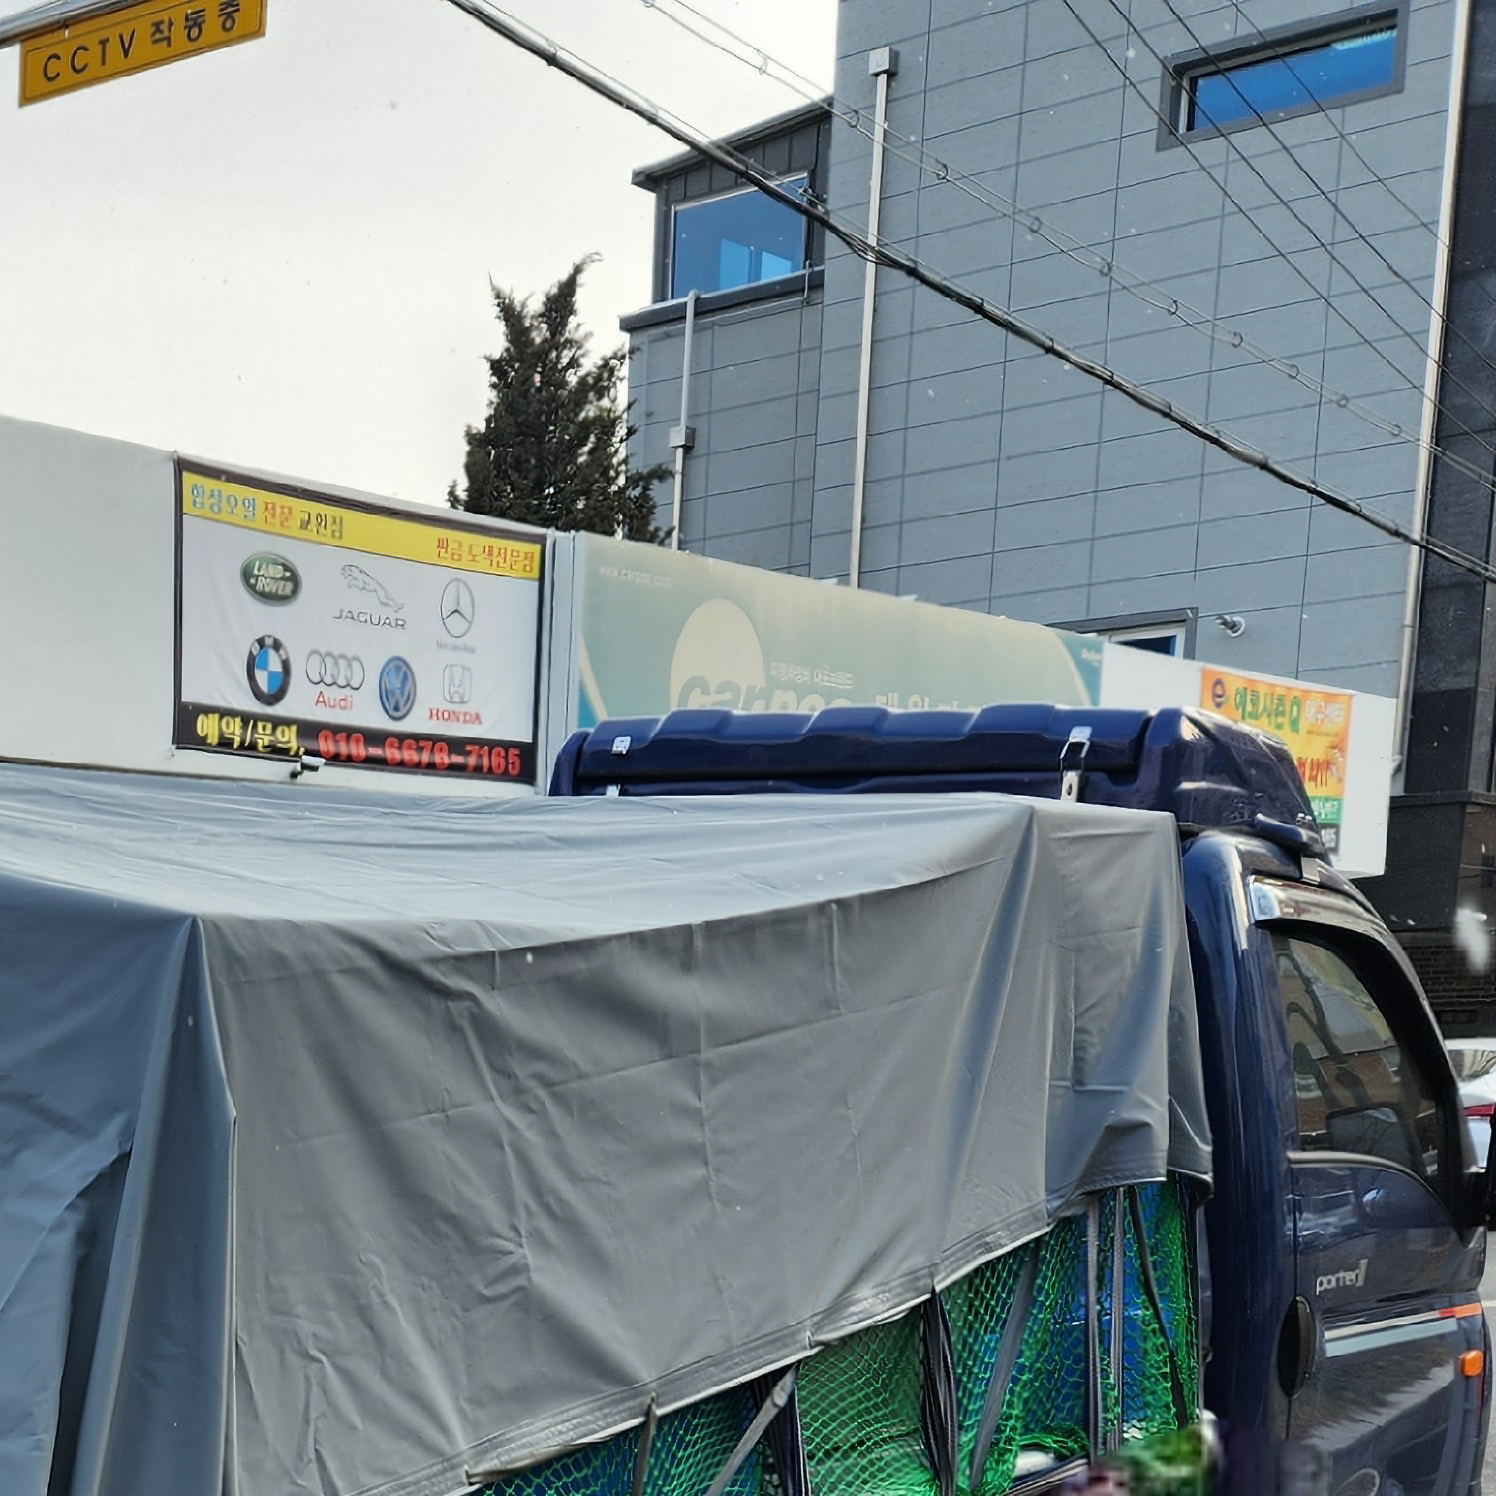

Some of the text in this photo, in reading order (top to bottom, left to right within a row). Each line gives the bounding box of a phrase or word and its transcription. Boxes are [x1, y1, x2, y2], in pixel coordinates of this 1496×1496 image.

[42, 0, 241, 82] CCTV 작동중
[332, 609, 407, 630] JAGUAR
[315, 691, 354, 711] Audi
[428, 707, 483, 725] HONDA
[316, 729, 521, 777] 010-6678-7165
